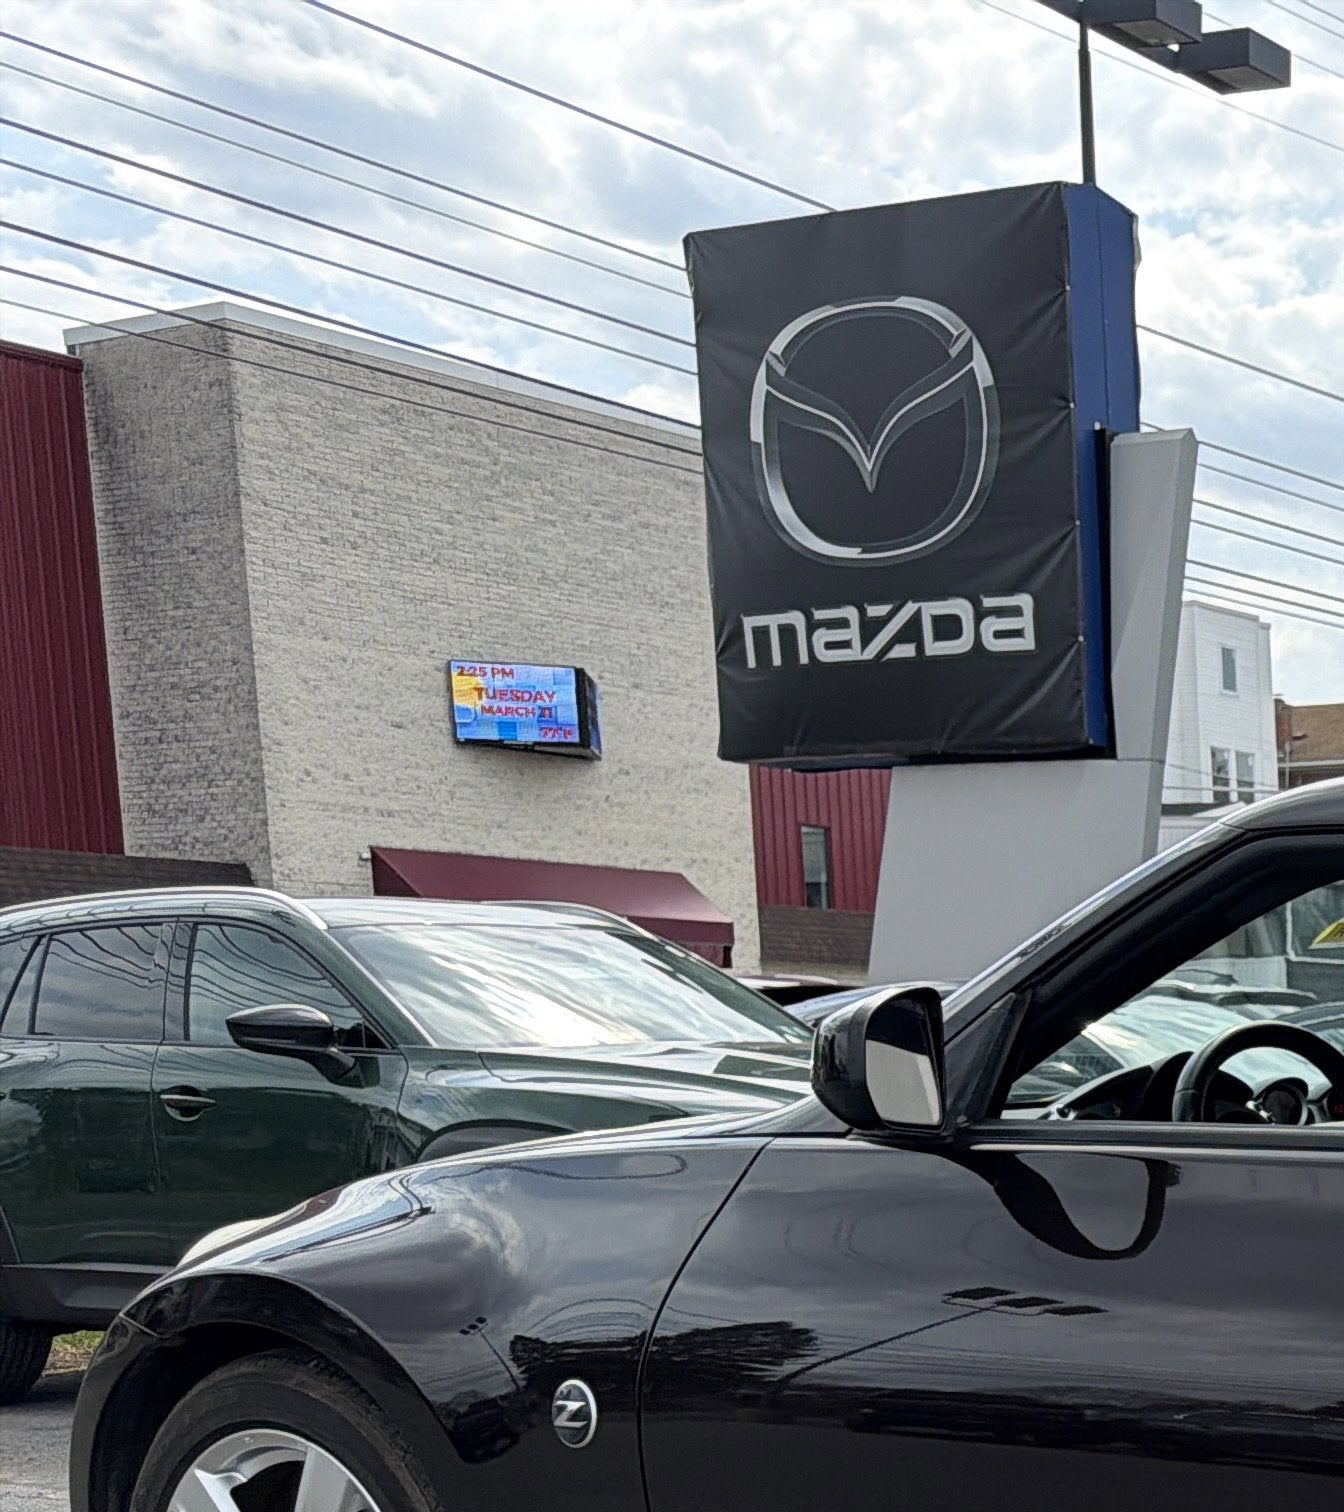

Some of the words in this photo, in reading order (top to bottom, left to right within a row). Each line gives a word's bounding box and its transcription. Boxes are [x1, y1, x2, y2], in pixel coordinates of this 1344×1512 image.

[491, 667, 515, 679] PM
[474, 687, 557, 703] TUESDAY
[480, 705, 536, 718] MARCH
[554, 1400, 588, 1428] Z
